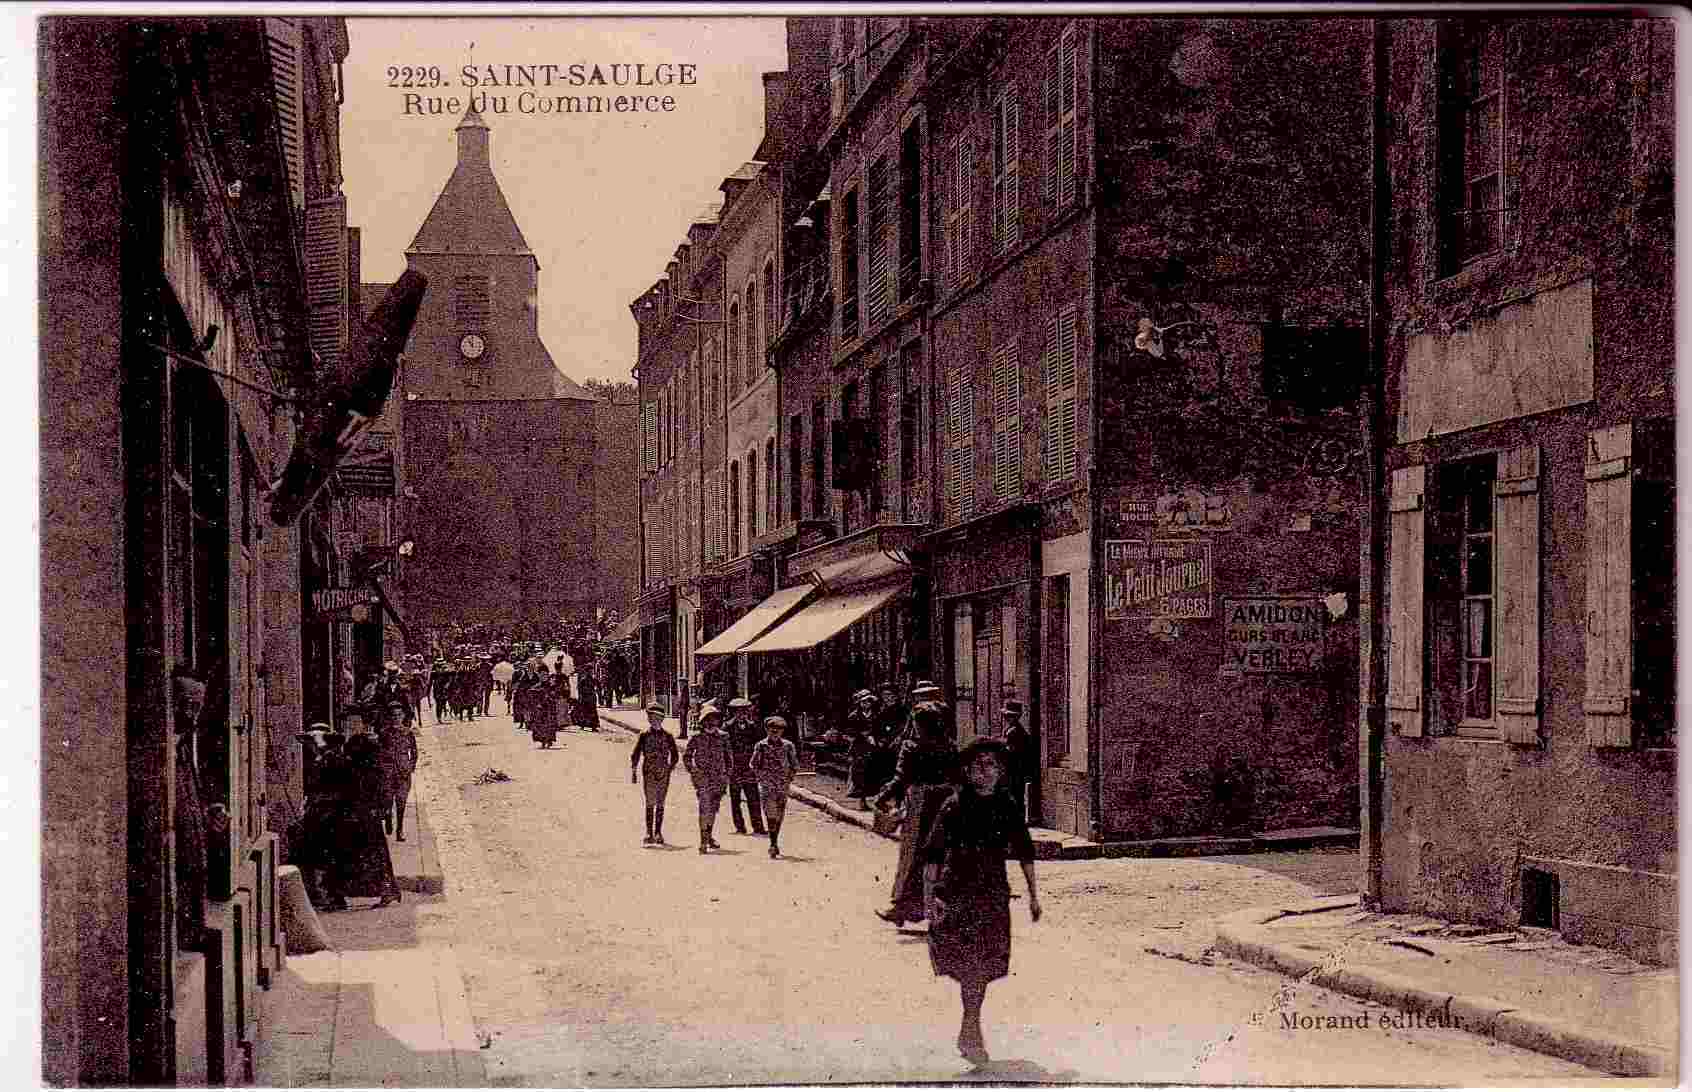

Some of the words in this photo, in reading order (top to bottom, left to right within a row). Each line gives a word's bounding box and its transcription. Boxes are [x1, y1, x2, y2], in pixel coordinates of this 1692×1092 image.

[1126, 563, 1155, 606] Petit
[1157, 547, 1209, 597] Journal
[1232, 605, 1320, 623] AMIDON
[1233, 649, 1315, 667] VERLEY
